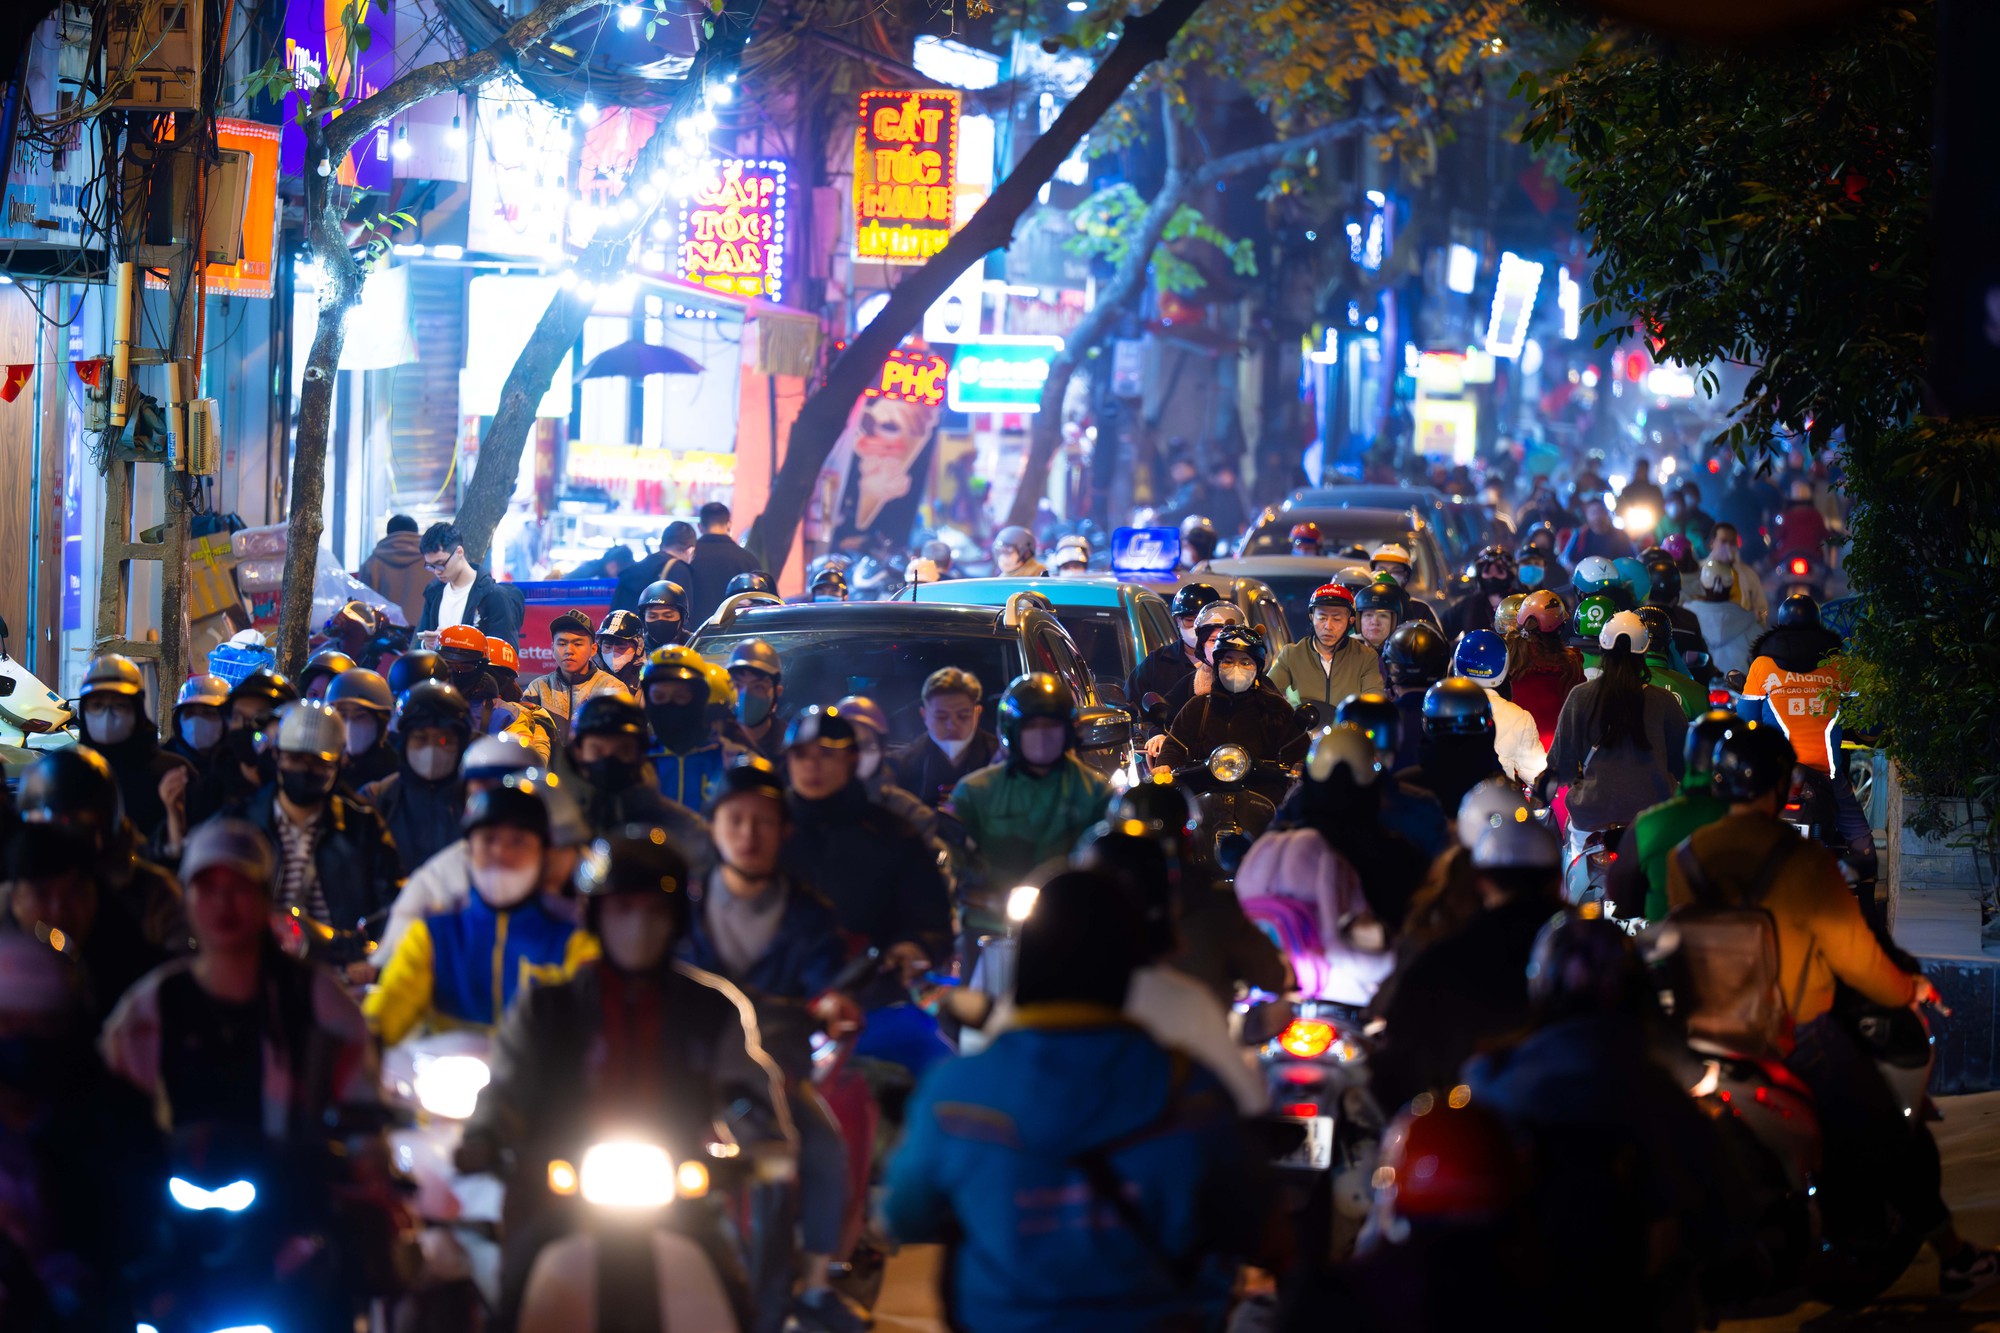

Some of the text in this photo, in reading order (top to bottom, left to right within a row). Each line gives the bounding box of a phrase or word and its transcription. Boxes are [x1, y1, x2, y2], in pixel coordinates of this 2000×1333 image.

[873, 95, 944, 143] CẮT
[874, 143, 942, 185] TÓC
[690, 204, 773, 243] TÓC
[519, 646, 554, 660] ette
